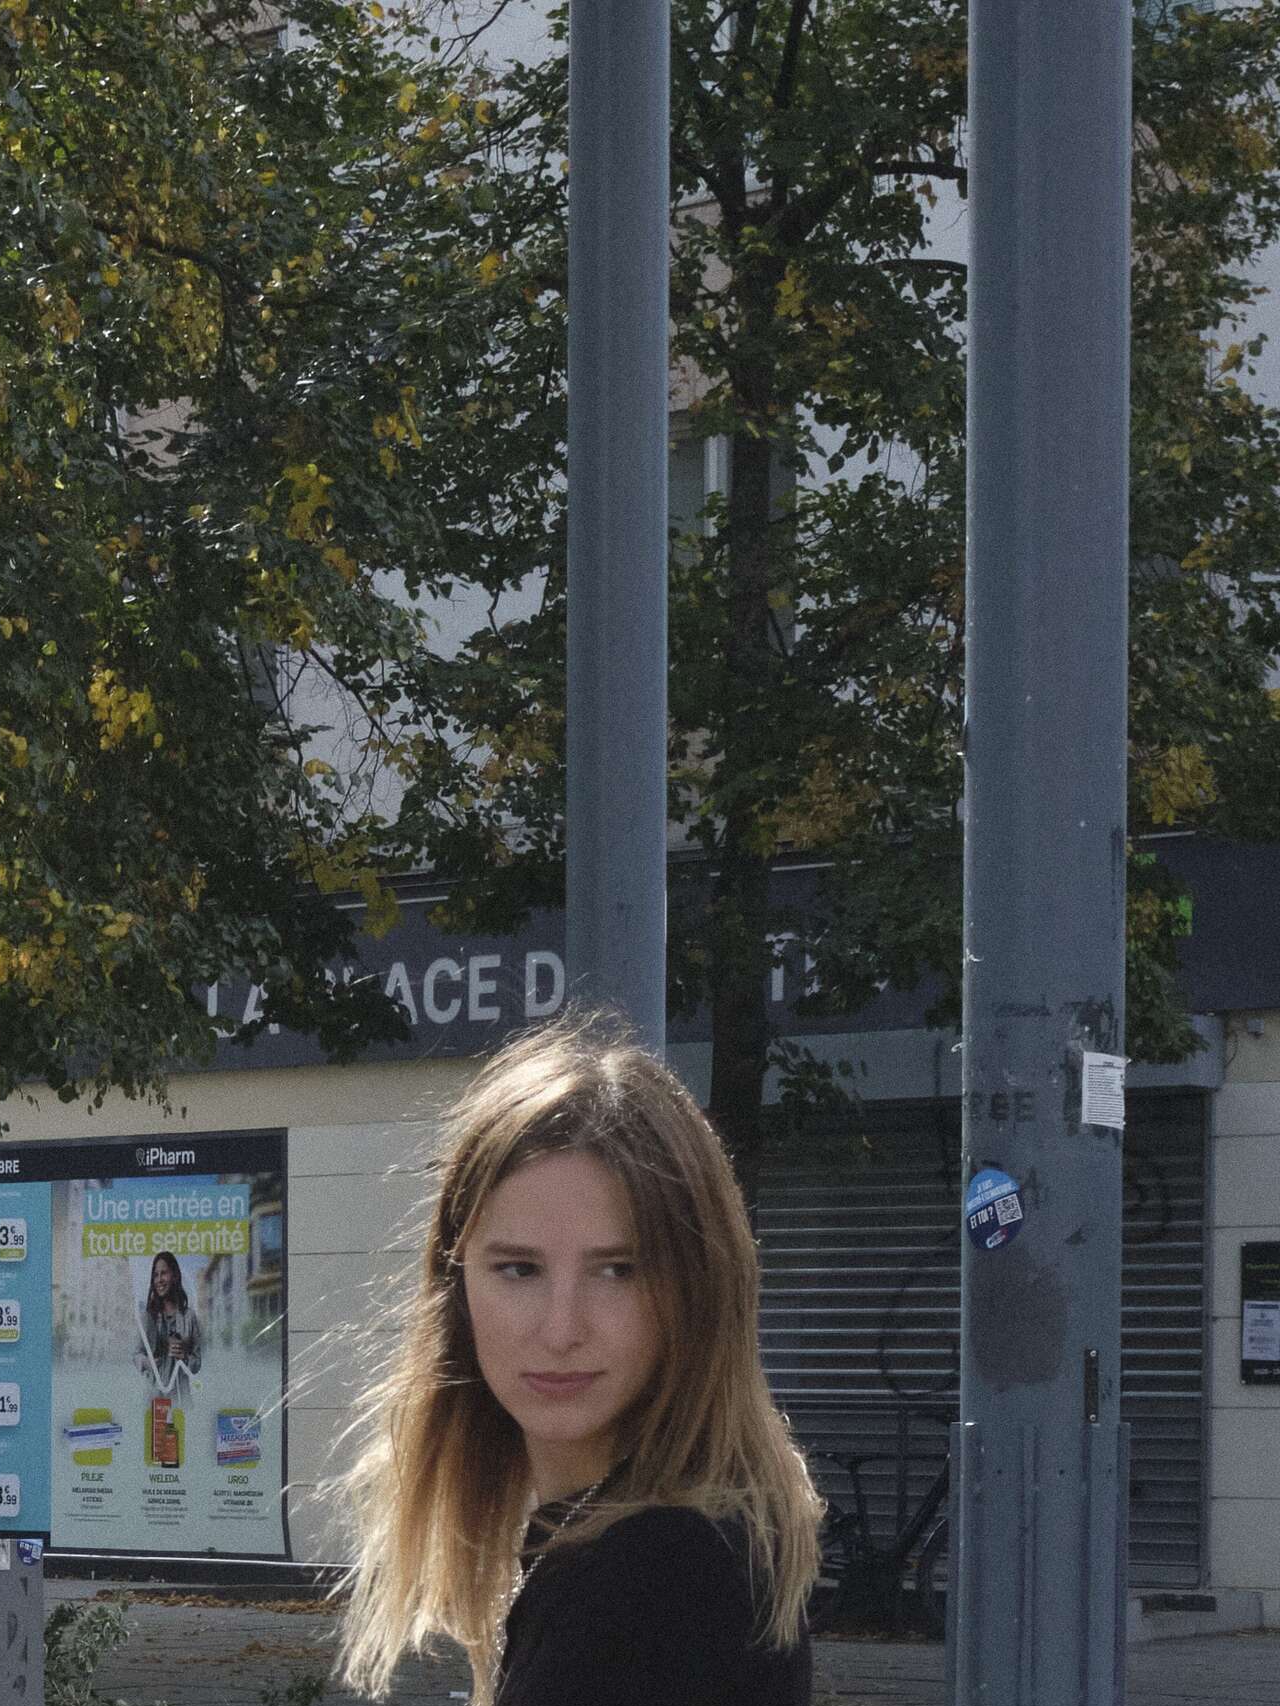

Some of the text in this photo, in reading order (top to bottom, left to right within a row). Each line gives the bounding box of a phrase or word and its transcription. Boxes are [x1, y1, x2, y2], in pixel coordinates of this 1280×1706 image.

[320, 954, 501, 1030] ACE
[146, 1148, 195, 1165] iPharm
[88, 1190, 245, 1220] Une rentrée en
[88, 1222, 244, 1254] toute sérénité
[149, 1474, 179, 1484] WELEDA
